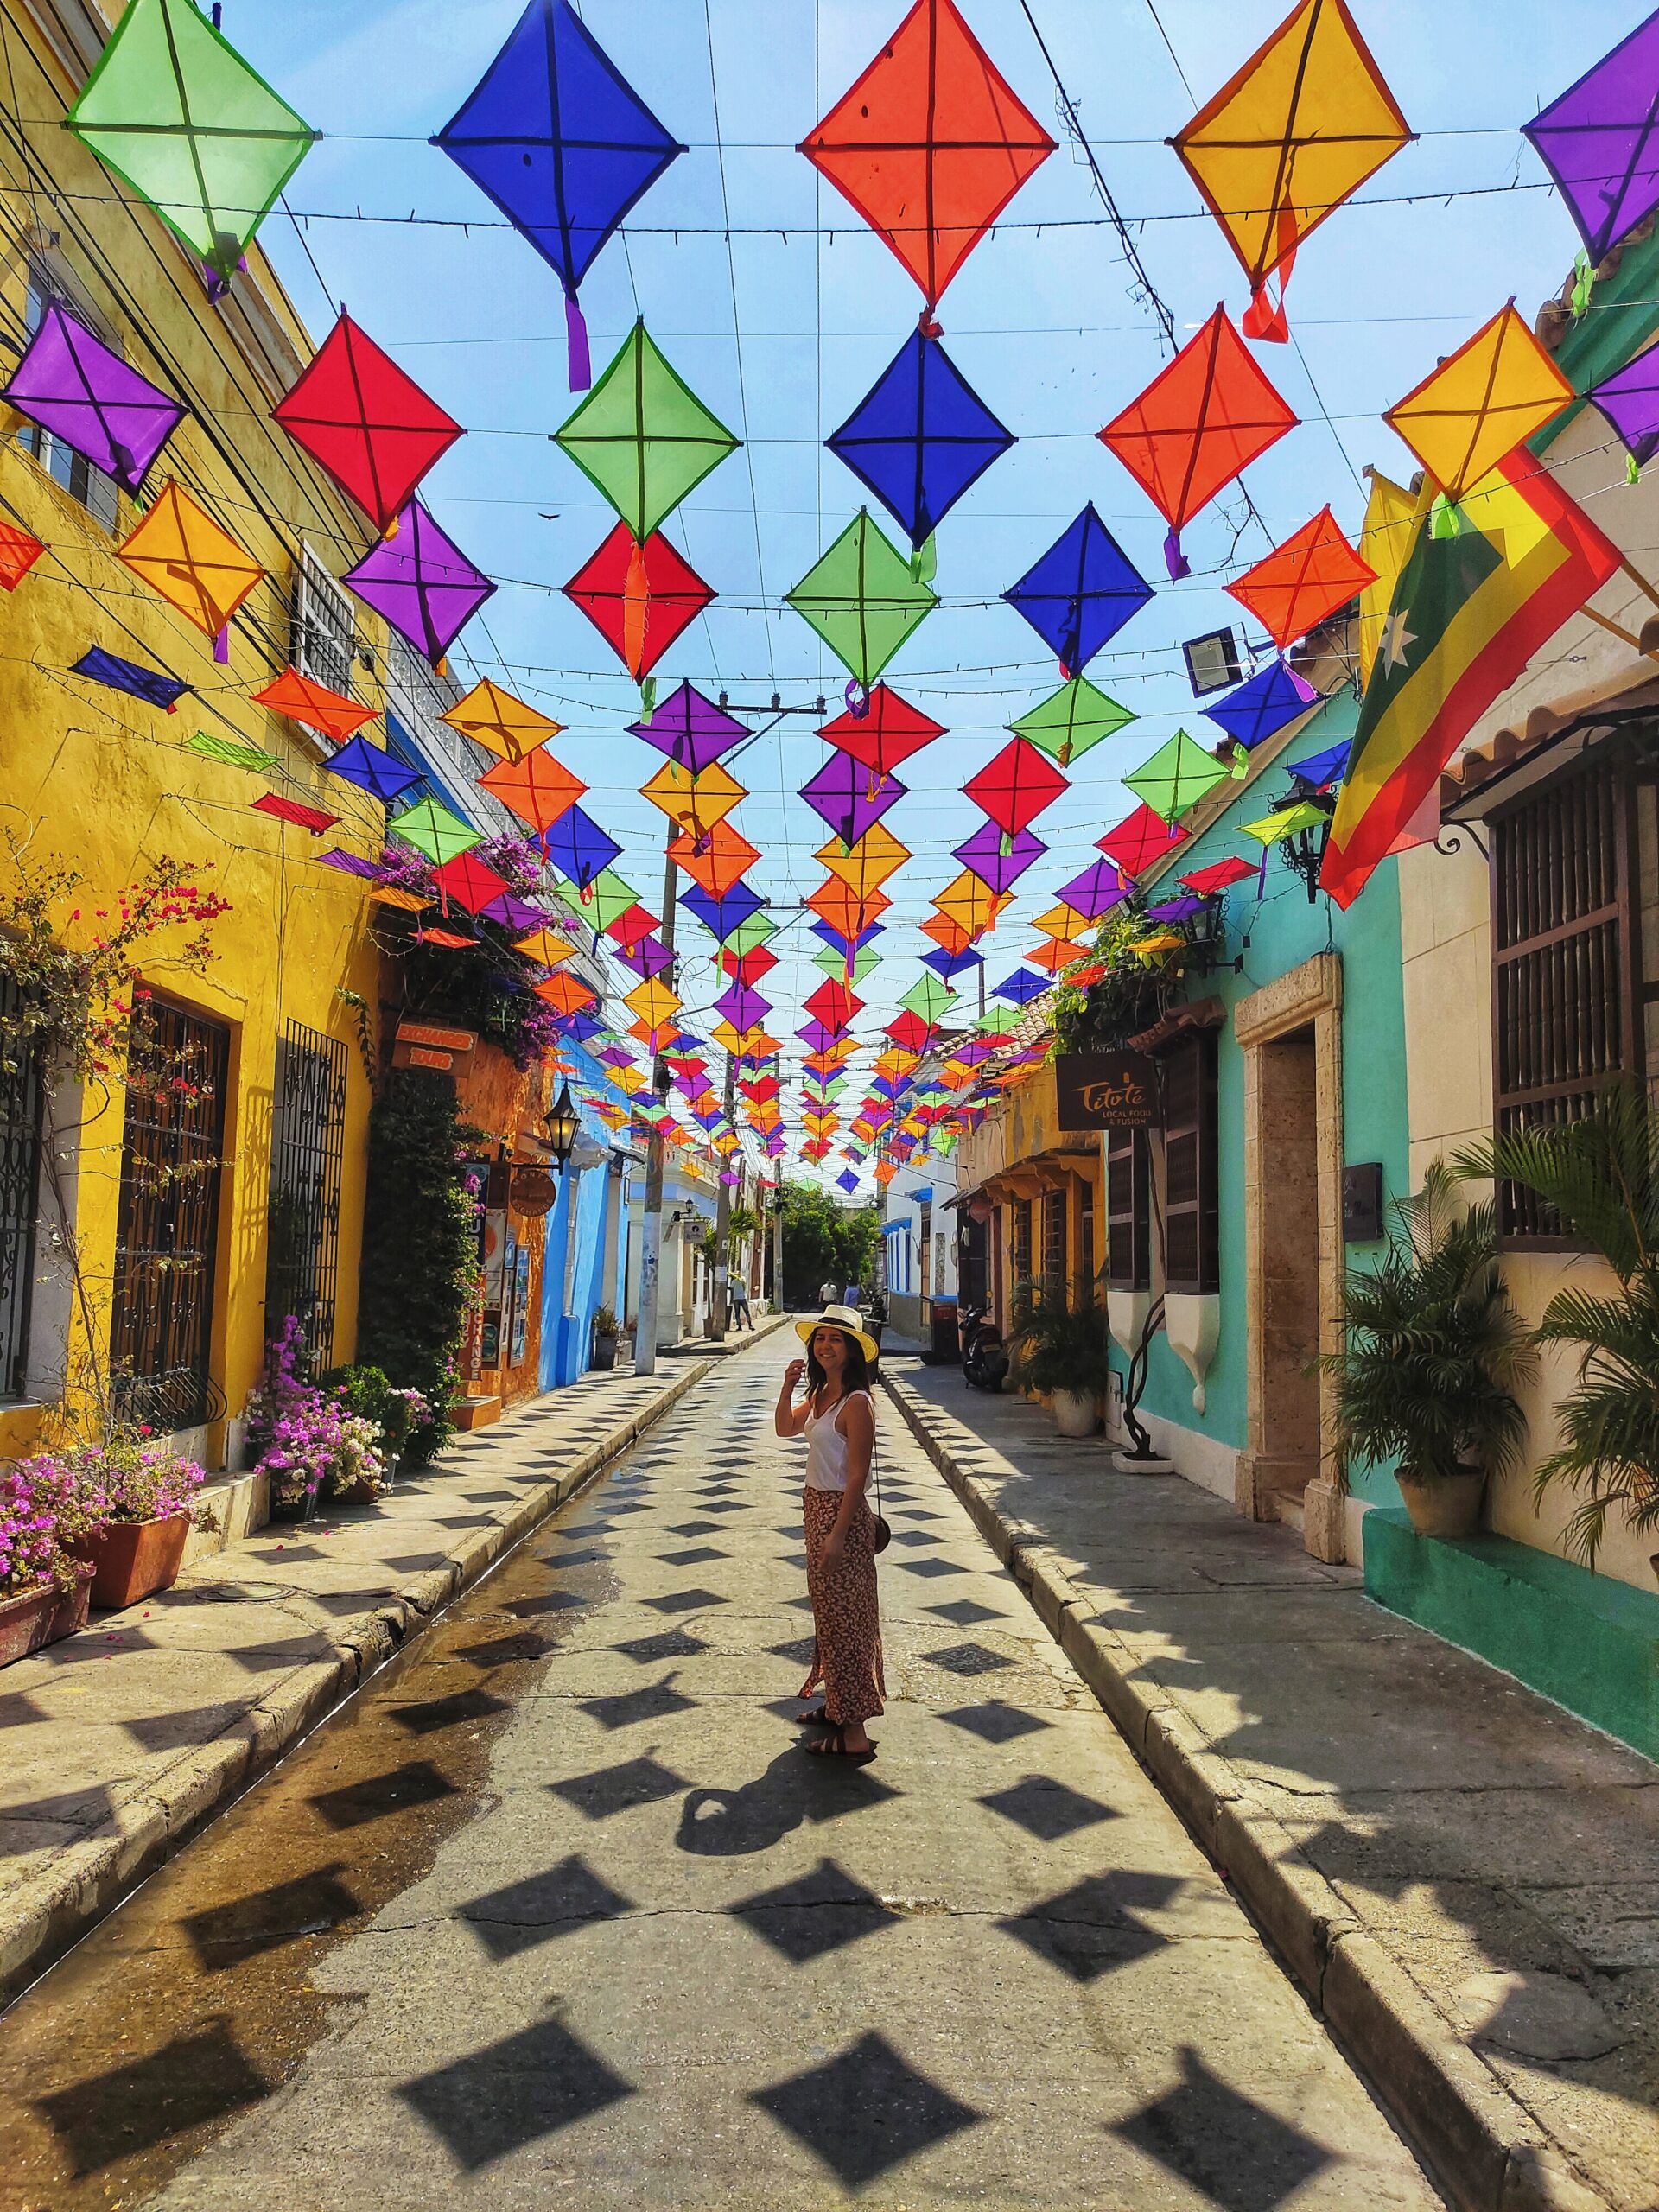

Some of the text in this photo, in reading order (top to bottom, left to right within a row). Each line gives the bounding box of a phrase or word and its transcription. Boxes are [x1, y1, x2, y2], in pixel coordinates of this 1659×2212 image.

[410, 1047, 454, 1071] TOURS
[1071, 1081, 1145, 1112] Titoté
[1116, 1117, 1147, 1126] FUSION
[1129, 1109, 1152, 1117] FOOD
[512, 1172, 551, 1187] MONEY
[512, 1197, 553, 1216] EXCHANGE
